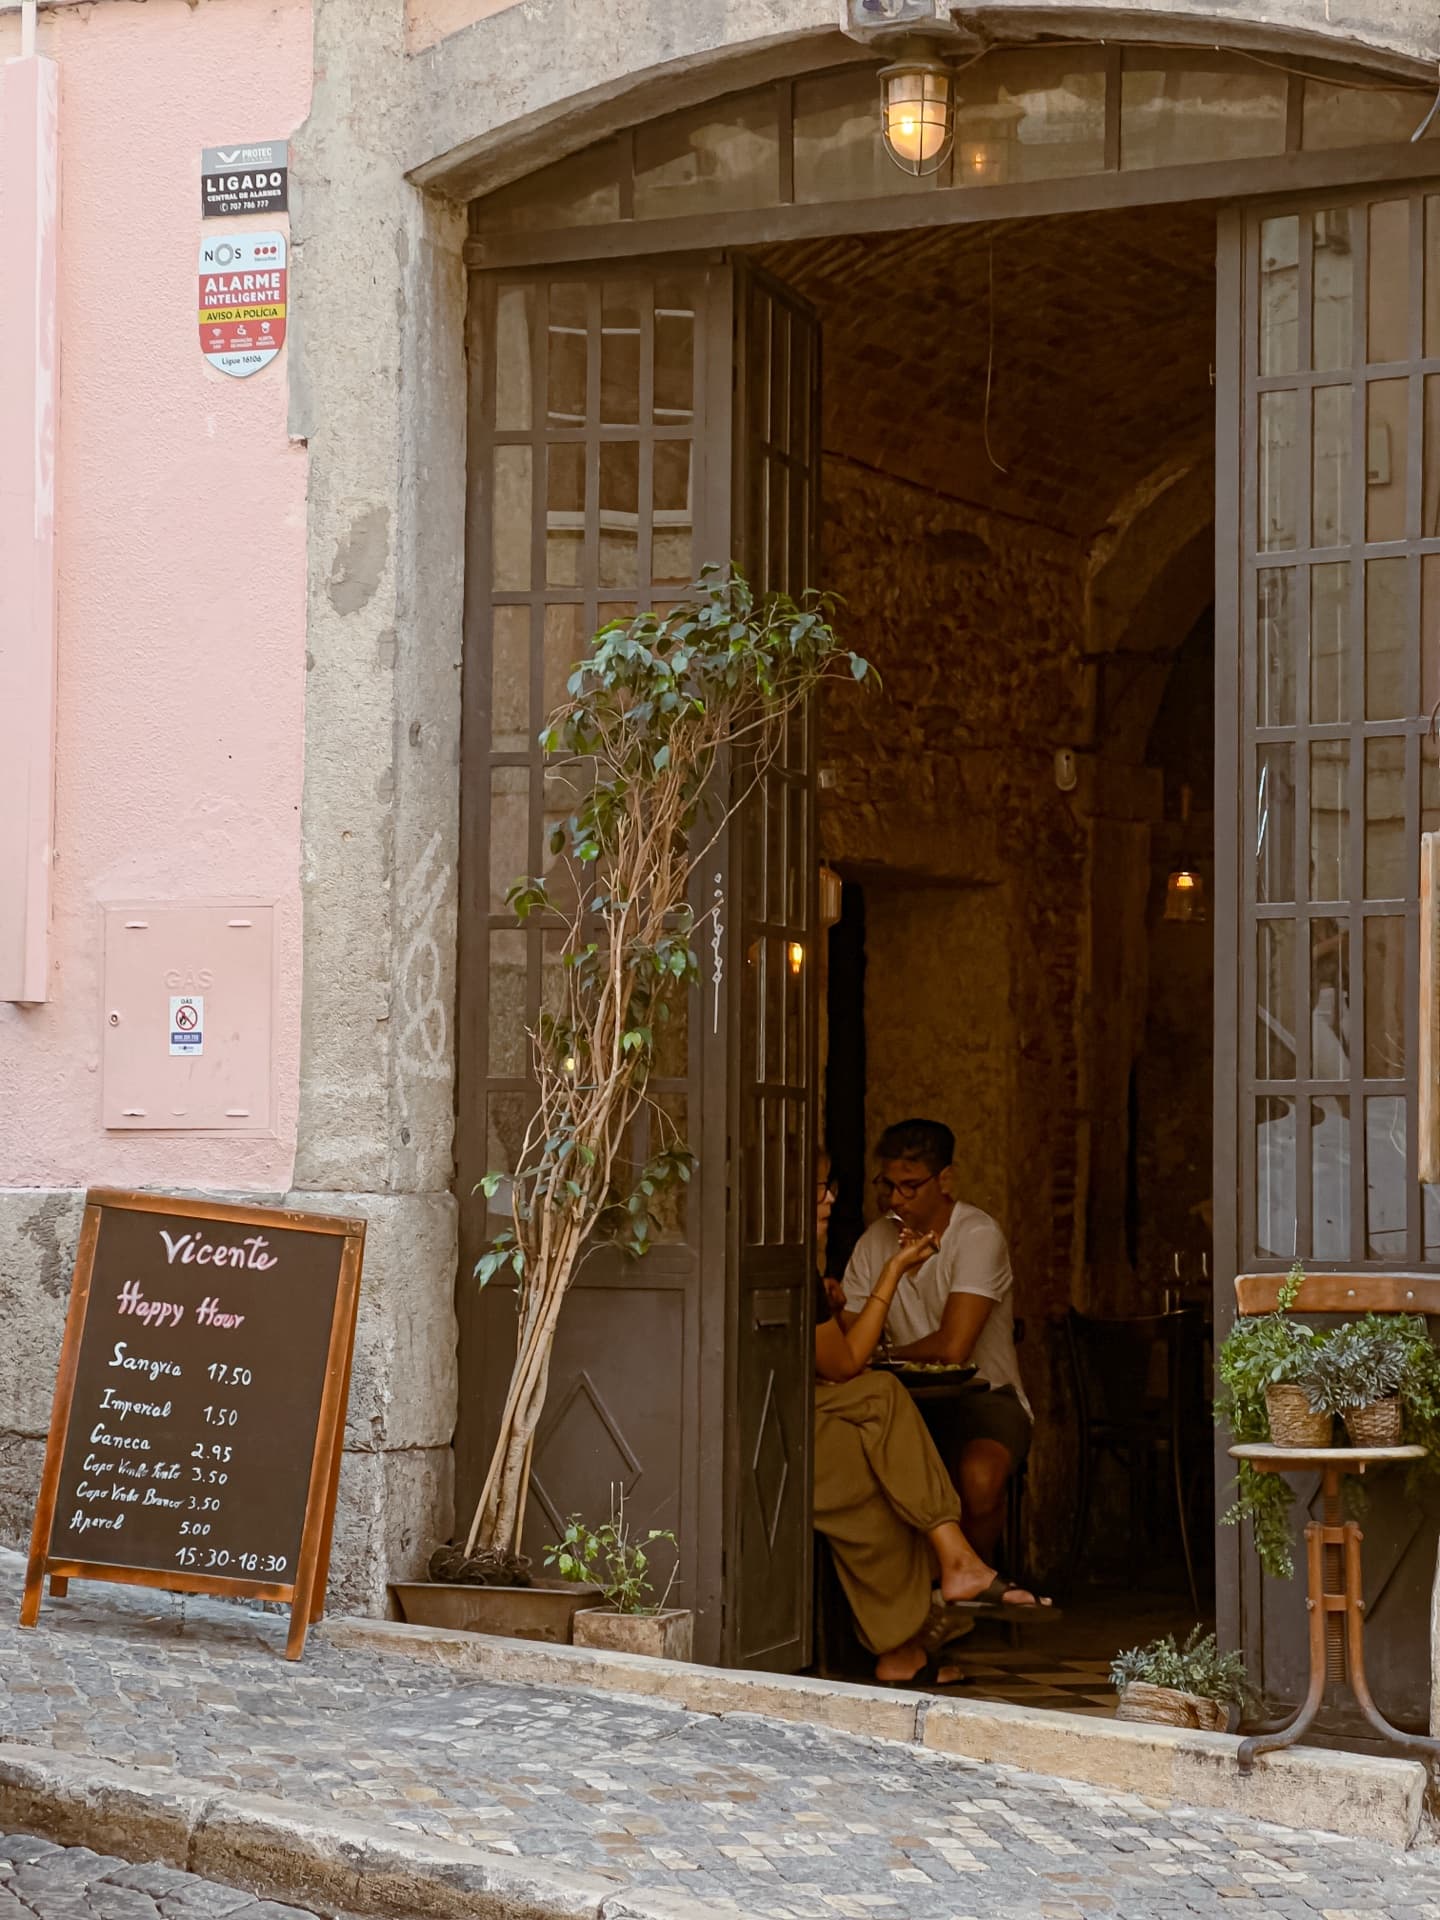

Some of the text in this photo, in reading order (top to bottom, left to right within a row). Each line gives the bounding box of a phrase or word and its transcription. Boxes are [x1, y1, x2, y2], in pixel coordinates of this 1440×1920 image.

[242, 147, 272, 158] PROTEC
[206, 172, 282, 193] LIGADO
[207, 189, 282, 202] CENTRAL DE ALARMES
[204, 243, 242, 267] NOS
[204, 272, 281, 293] ALARME
[204, 290, 280, 305] INTELIGENTE
[206, 310, 233, 321] AVISO
[243, 308, 278, 319] POLÍCIA
[159, 1230, 279, 1271] Vicente
[116, 1280, 245, 1329] Happy Hour
[108, 1341, 252, 1386] Sangria 17.50
[99, 1388, 238, 1426] Imperial 1.50
[90, 1422, 232, 1463] Caneca 2.95
[83, 1453, 115, 1476] Copo
[118, 1458, 149, 1478] Vinho
[191, 1467, 228, 1485] 3.50
[76, 1480, 220, 1511] Copo Vinho Branco 3.50
[69, 1509, 211, 1535] Aperol 5.00
[175, 1547, 288, 1572] 15:30-18:30
